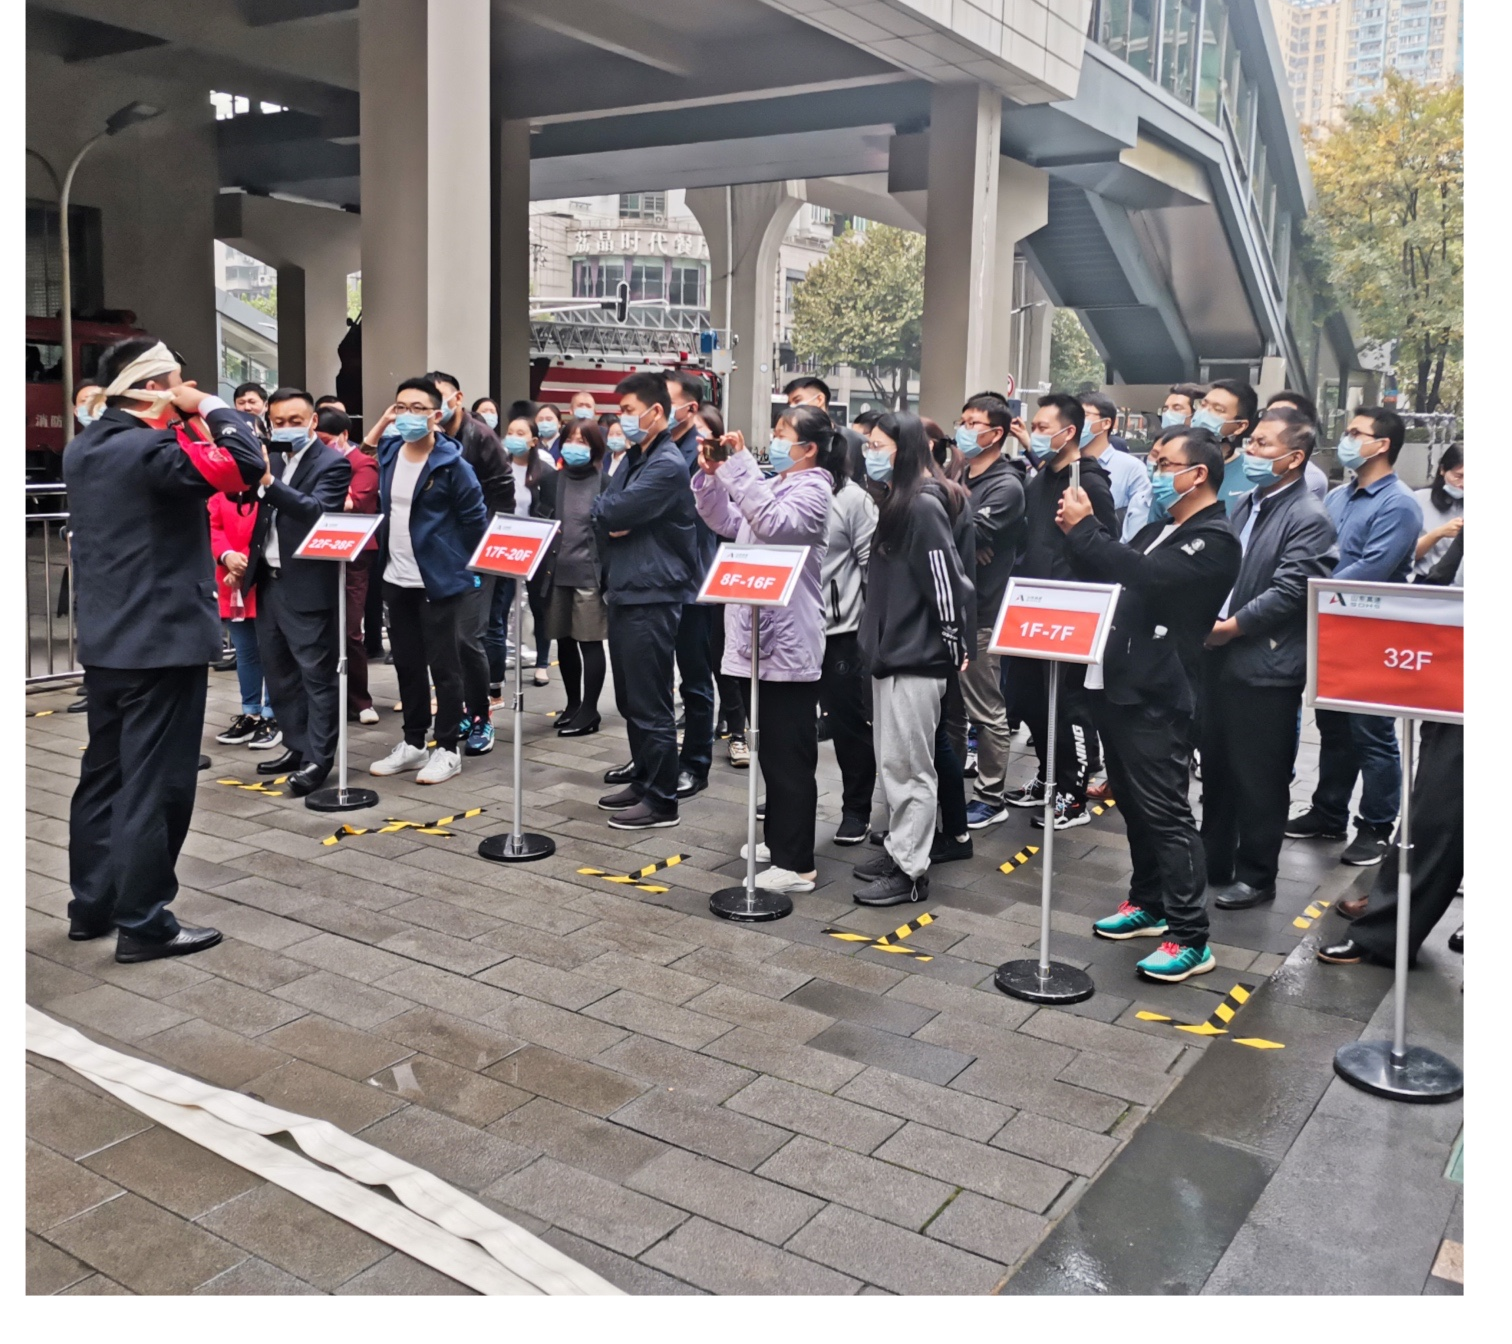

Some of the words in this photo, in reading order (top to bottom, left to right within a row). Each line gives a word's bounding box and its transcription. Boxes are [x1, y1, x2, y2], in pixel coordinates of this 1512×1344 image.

[308, 538, 355, 551] 22F-28F
[484, 545, 533, 562] 17F-20F
[719, 573, 776, 590] 8F-16F
[1020, 621, 1075, 641] 1F-7F
[1383, 647, 1433, 671] 32F
